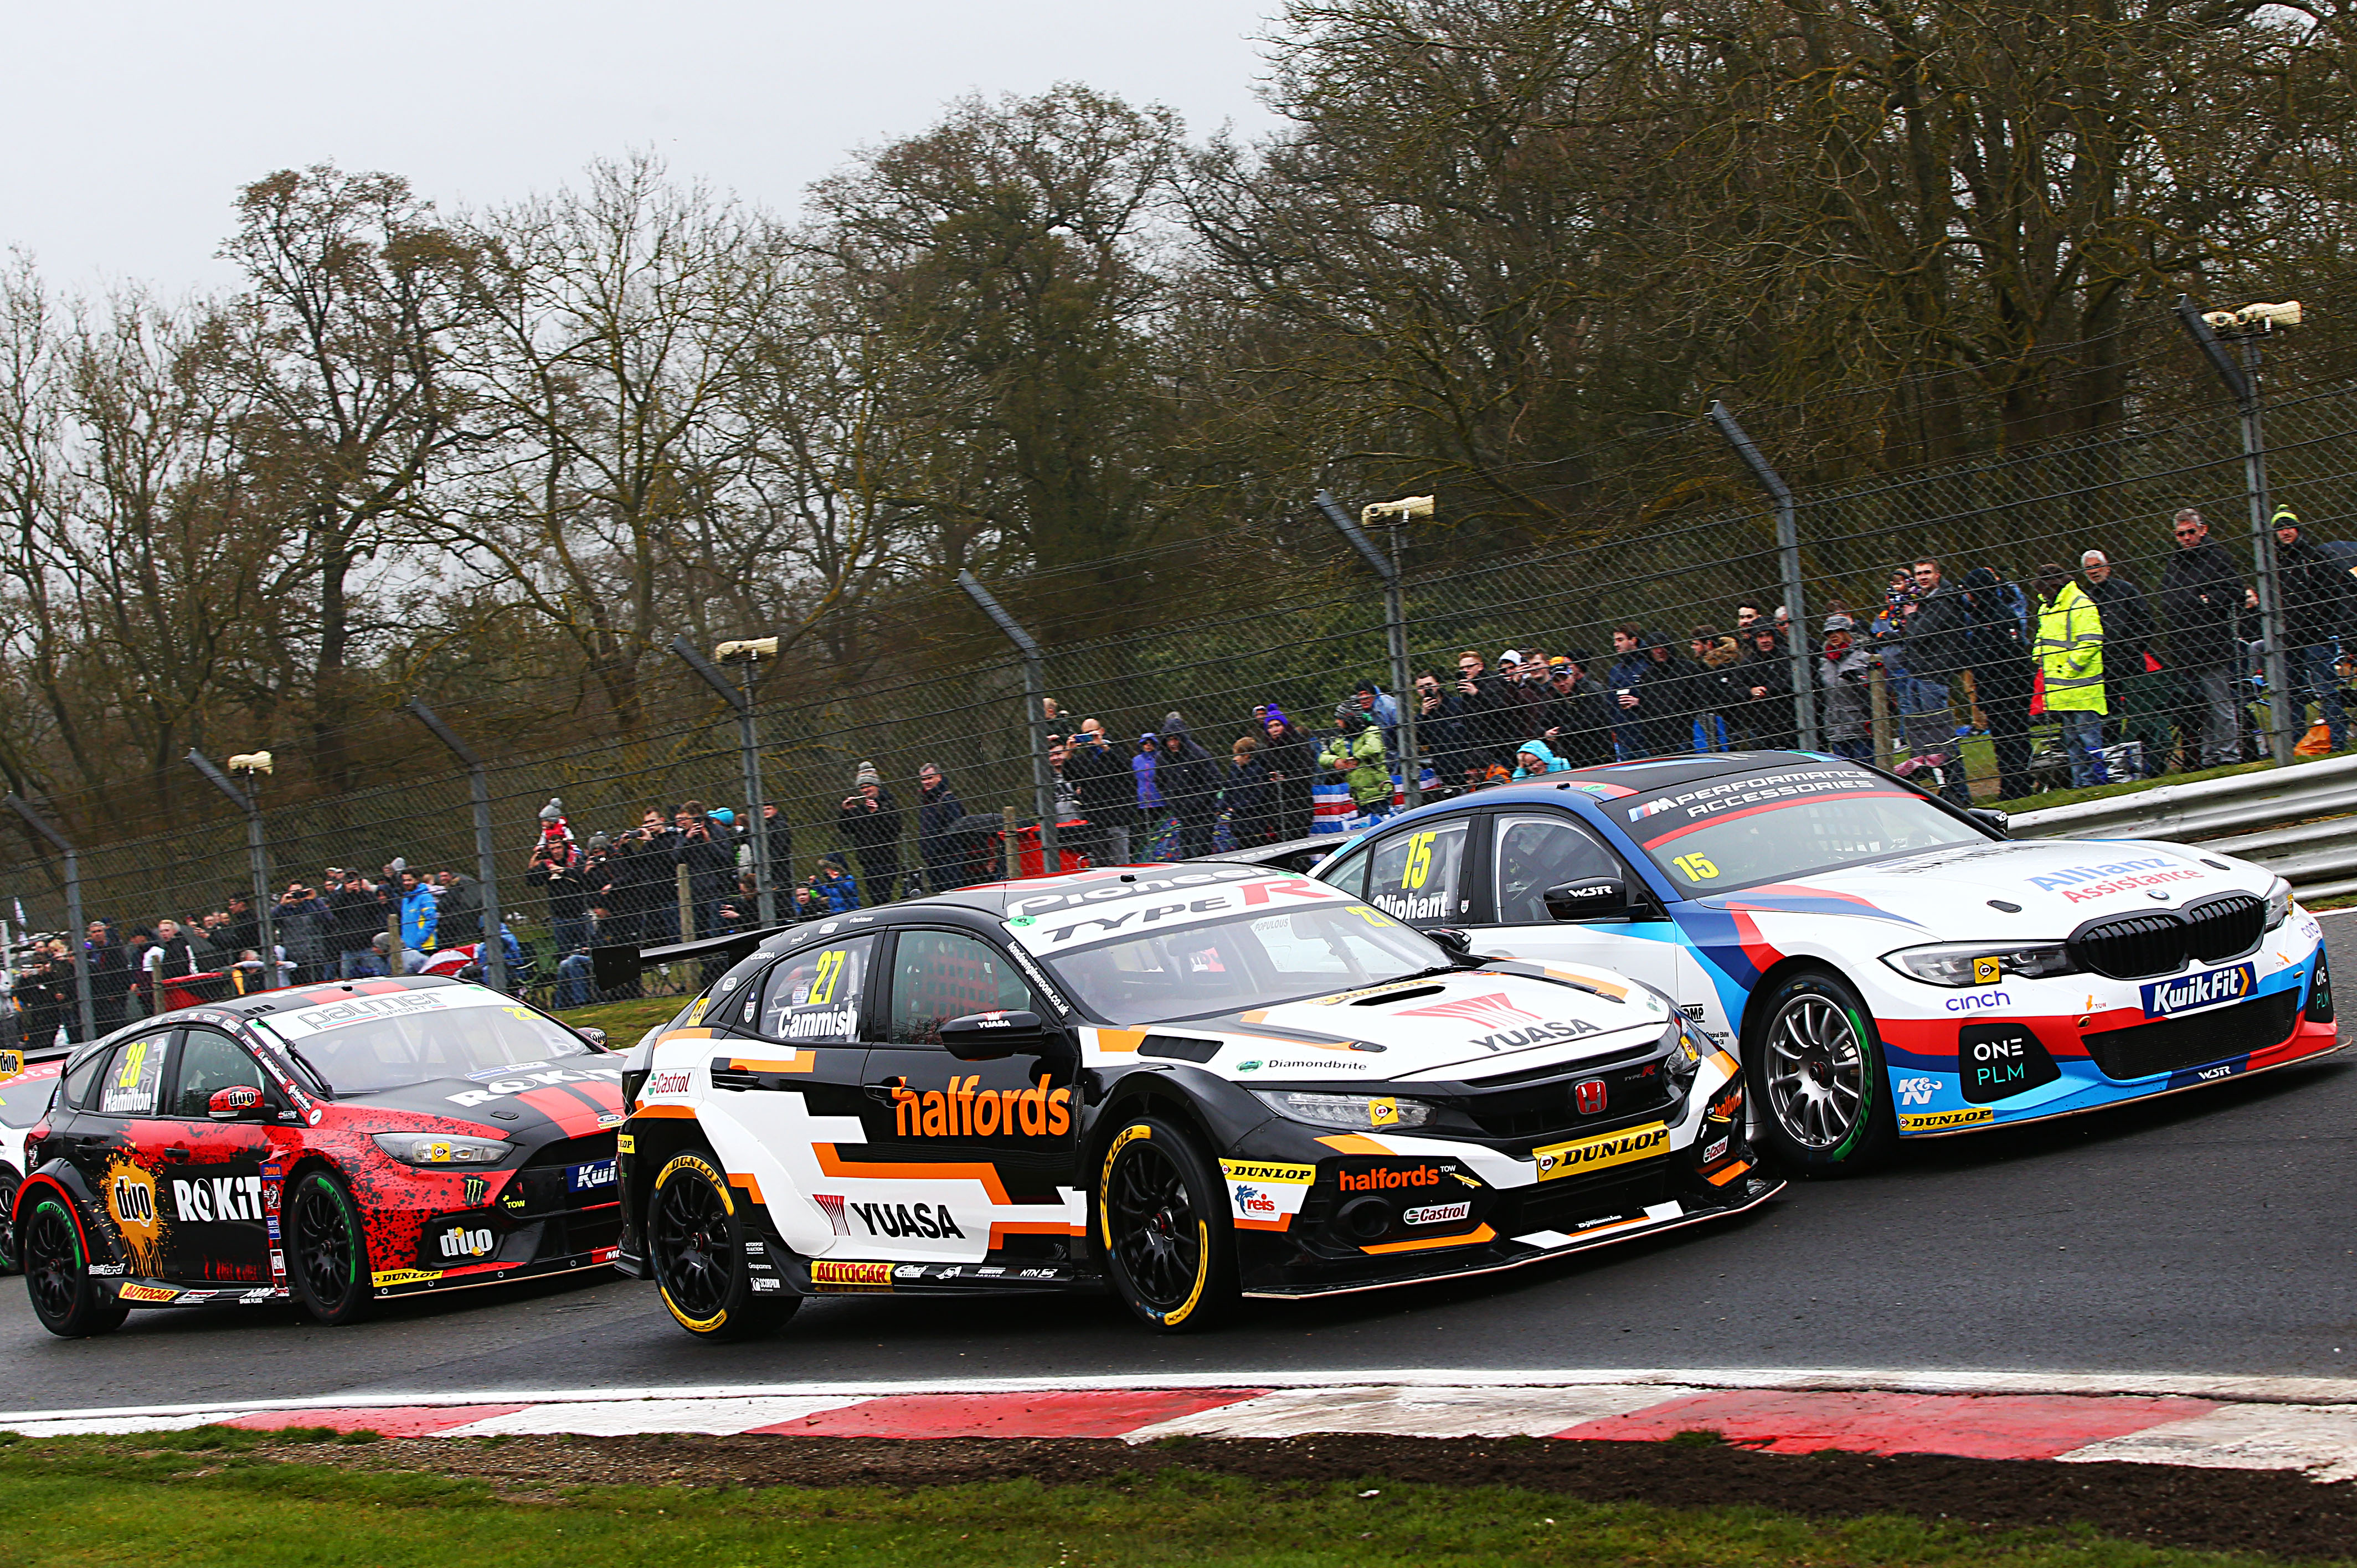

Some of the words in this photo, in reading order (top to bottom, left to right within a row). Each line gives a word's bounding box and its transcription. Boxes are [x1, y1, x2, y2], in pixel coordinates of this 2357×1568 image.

[1675, 770, 1876, 805] PERFORMANCE
[1687, 780, 1875, 818] ACCESSORIES
[1402, 831, 1437, 889] 15
[1672, 852, 1720, 882] 15
[2023, 858, 2180, 891] Allianz
[1568, 884, 1613, 898] WSR
[2061, 870, 2205, 904] Assistance
[1042, 896, 1232, 942] TYPE
[1238, 879, 1335, 905] R
[1345, 906, 1398, 927] 27
[1372, 891, 1448, 921] Oliphant
[1254, 919, 1289, 932] POPULOUS
[750, 951, 775, 961] COBRA
[808, 950, 847, 1005] 27
[1007, 941, 1071, 1017] hondaengineroom.co.uk
[2316, 966, 2327, 986] ONE
[297, 992, 443, 1030] palmer
[381, 1005, 428, 1017] SPORT
[1946, 991, 2011, 1011] cinch
[2317, 992, 2329, 1009] PLM
[778, 1003, 858, 1039] Cammish
[977, 1019, 1011, 1029] YUASA
[1468, 1018, 1603, 1051] YUASA
[1974, 1038, 2024, 1061] ONE
[118, 1041, 148, 1088] 28
[1269, 1059, 1367, 1071] Diamondbrite
[1977, 1062, 2025, 1085] PLM
[2198, 1066, 2231, 1080] WSR
[444, 1069, 622, 1107] ROKiT
[656, 1072, 690, 1094] Castrol
[103, 1089, 152, 1113] Hamilton
[228, 1091, 256, 1106] duo
[892, 1074, 1072, 1136] halfords
[1911, 1110, 1992, 1127] DUNLOP
[1561, 1127, 1669, 1167] DUNLOP
[672, 1156, 723, 1189] DUNLOP
[1233, 1166, 1311, 1180] DUNLOP
[1339, 1164, 1439, 1192] halfords
[114, 1175, 153, 1226] duo
[172, 1176, 262, 1221] ROKiT
[506, 1200, 526, 1209] TOW
[1247, 1193, 1275, 1211] reis
[850, 1203, 966, 1239] YUASA
[1420, 1204, 1466, 1223] Castrol
[440, 1226, 493, 1257] duo
[381, 1270, 441, 1283] DUNLOP
[759, 1278, 780, 1289] SCORPION
[816, 1262, 889, 1283] AUTOCAR
[124, 1285, 175, 1301] AUTOCAR
